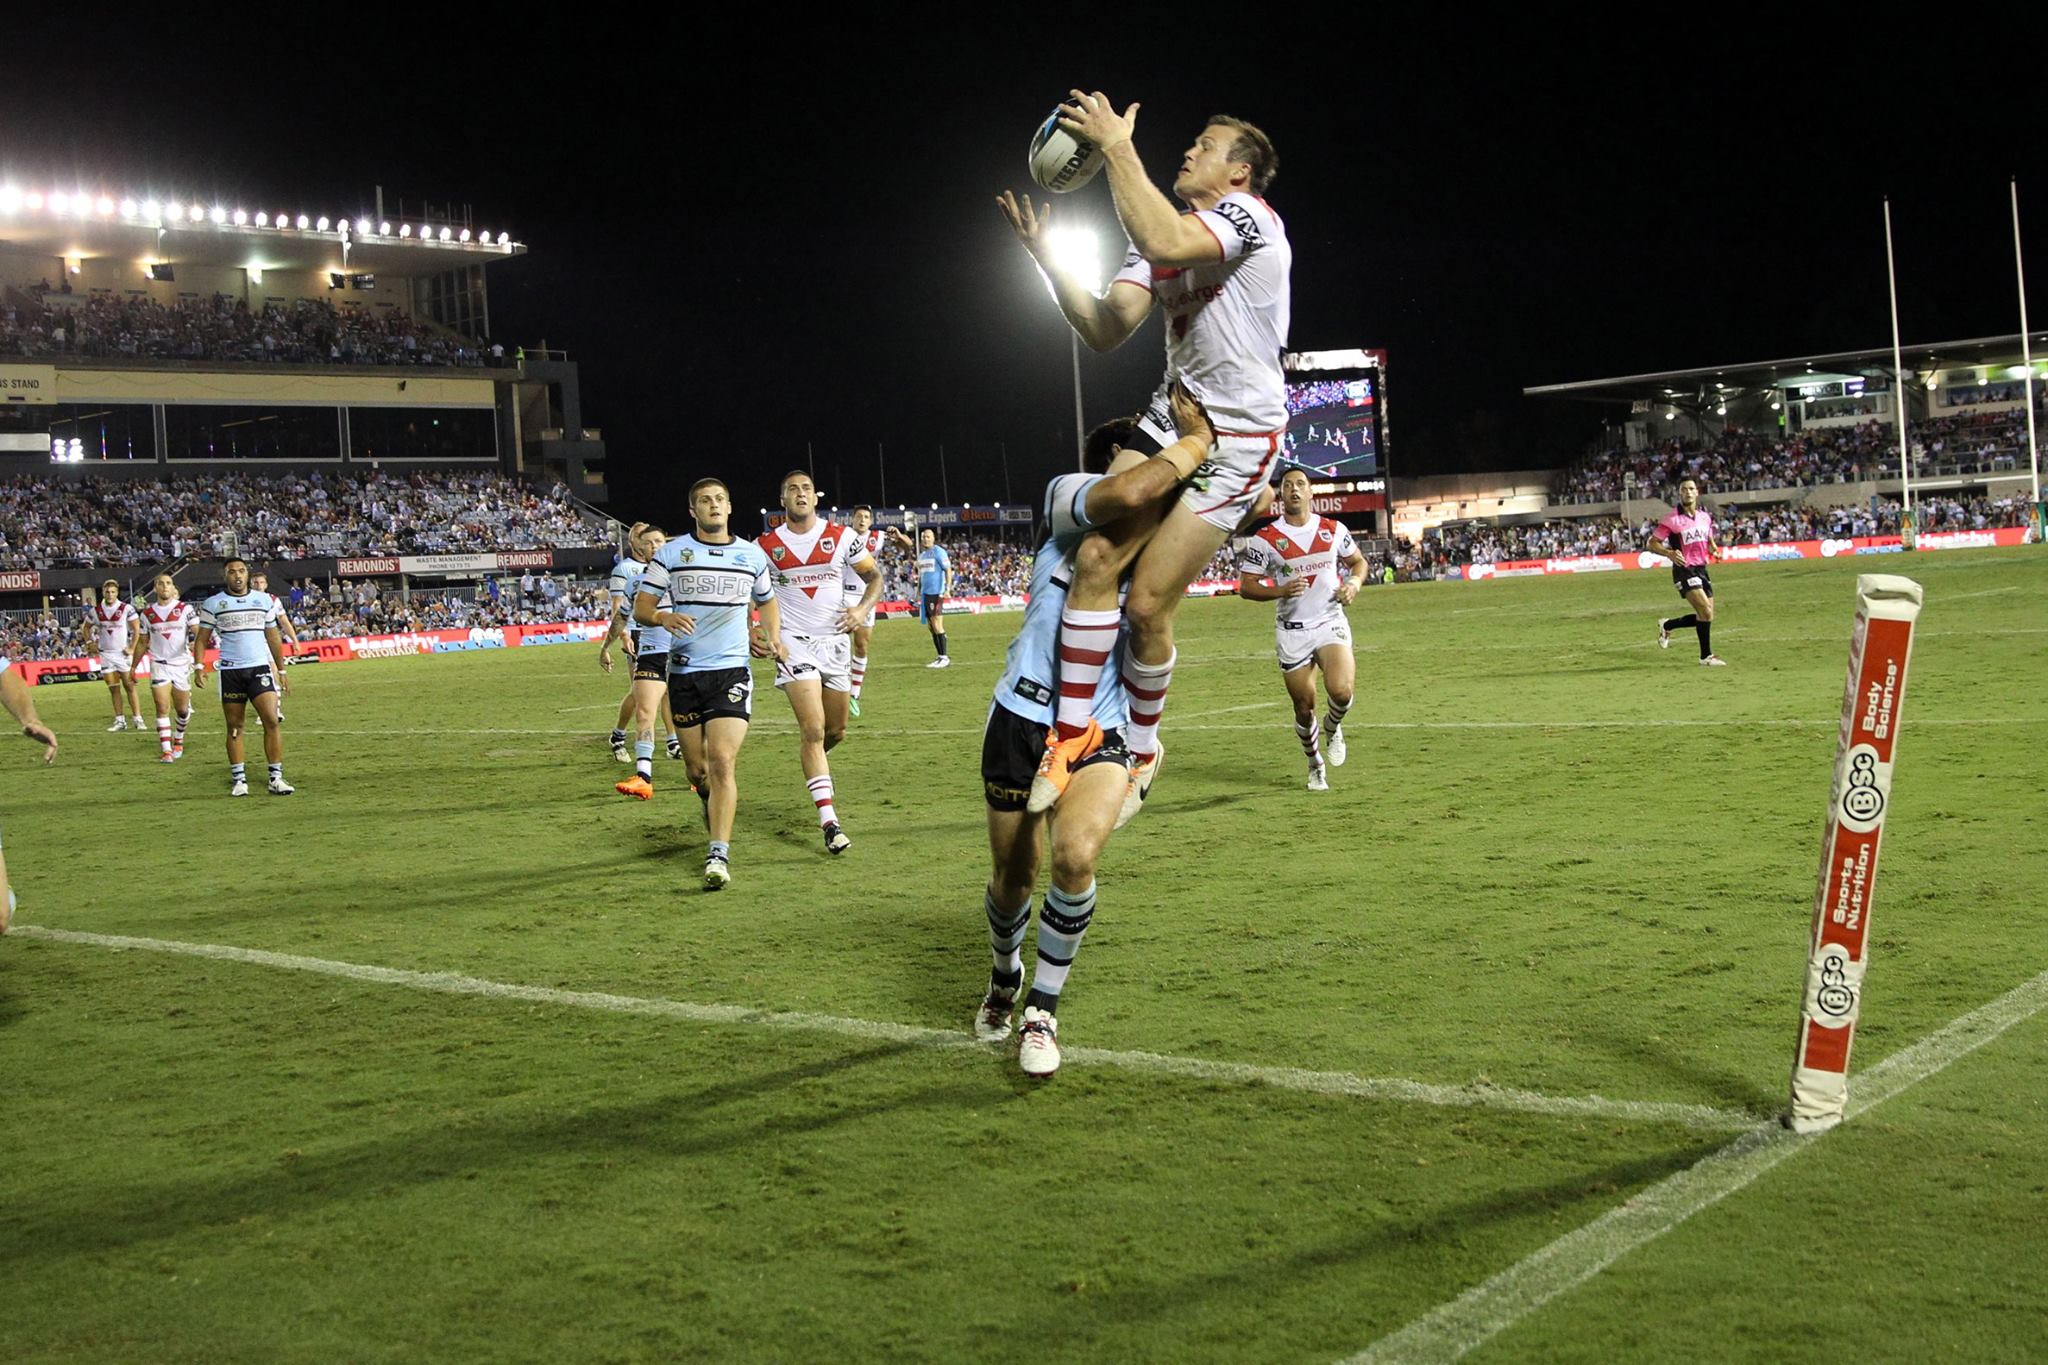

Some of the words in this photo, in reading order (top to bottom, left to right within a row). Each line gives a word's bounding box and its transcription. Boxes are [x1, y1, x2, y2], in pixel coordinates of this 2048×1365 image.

[1048, 141, 1093, 189] STEEDEN
[11, 378, 40, 389] STAND
[1270, 496, 1342, 515] RENDIS
[339, 559, 396, 573] REMONDIS
[497, 553, 548, 567] REMONDIS
[0, 574, 33, 589] NDIS
[677, 574, 754, 598] CSFC
[357, 645, 420, 659] GATORADE
[1862, 681, 1883, 732] Body
[1832, 857, 1854, 924] Sports
[1845, 843, 1870, 931] Nutrition
